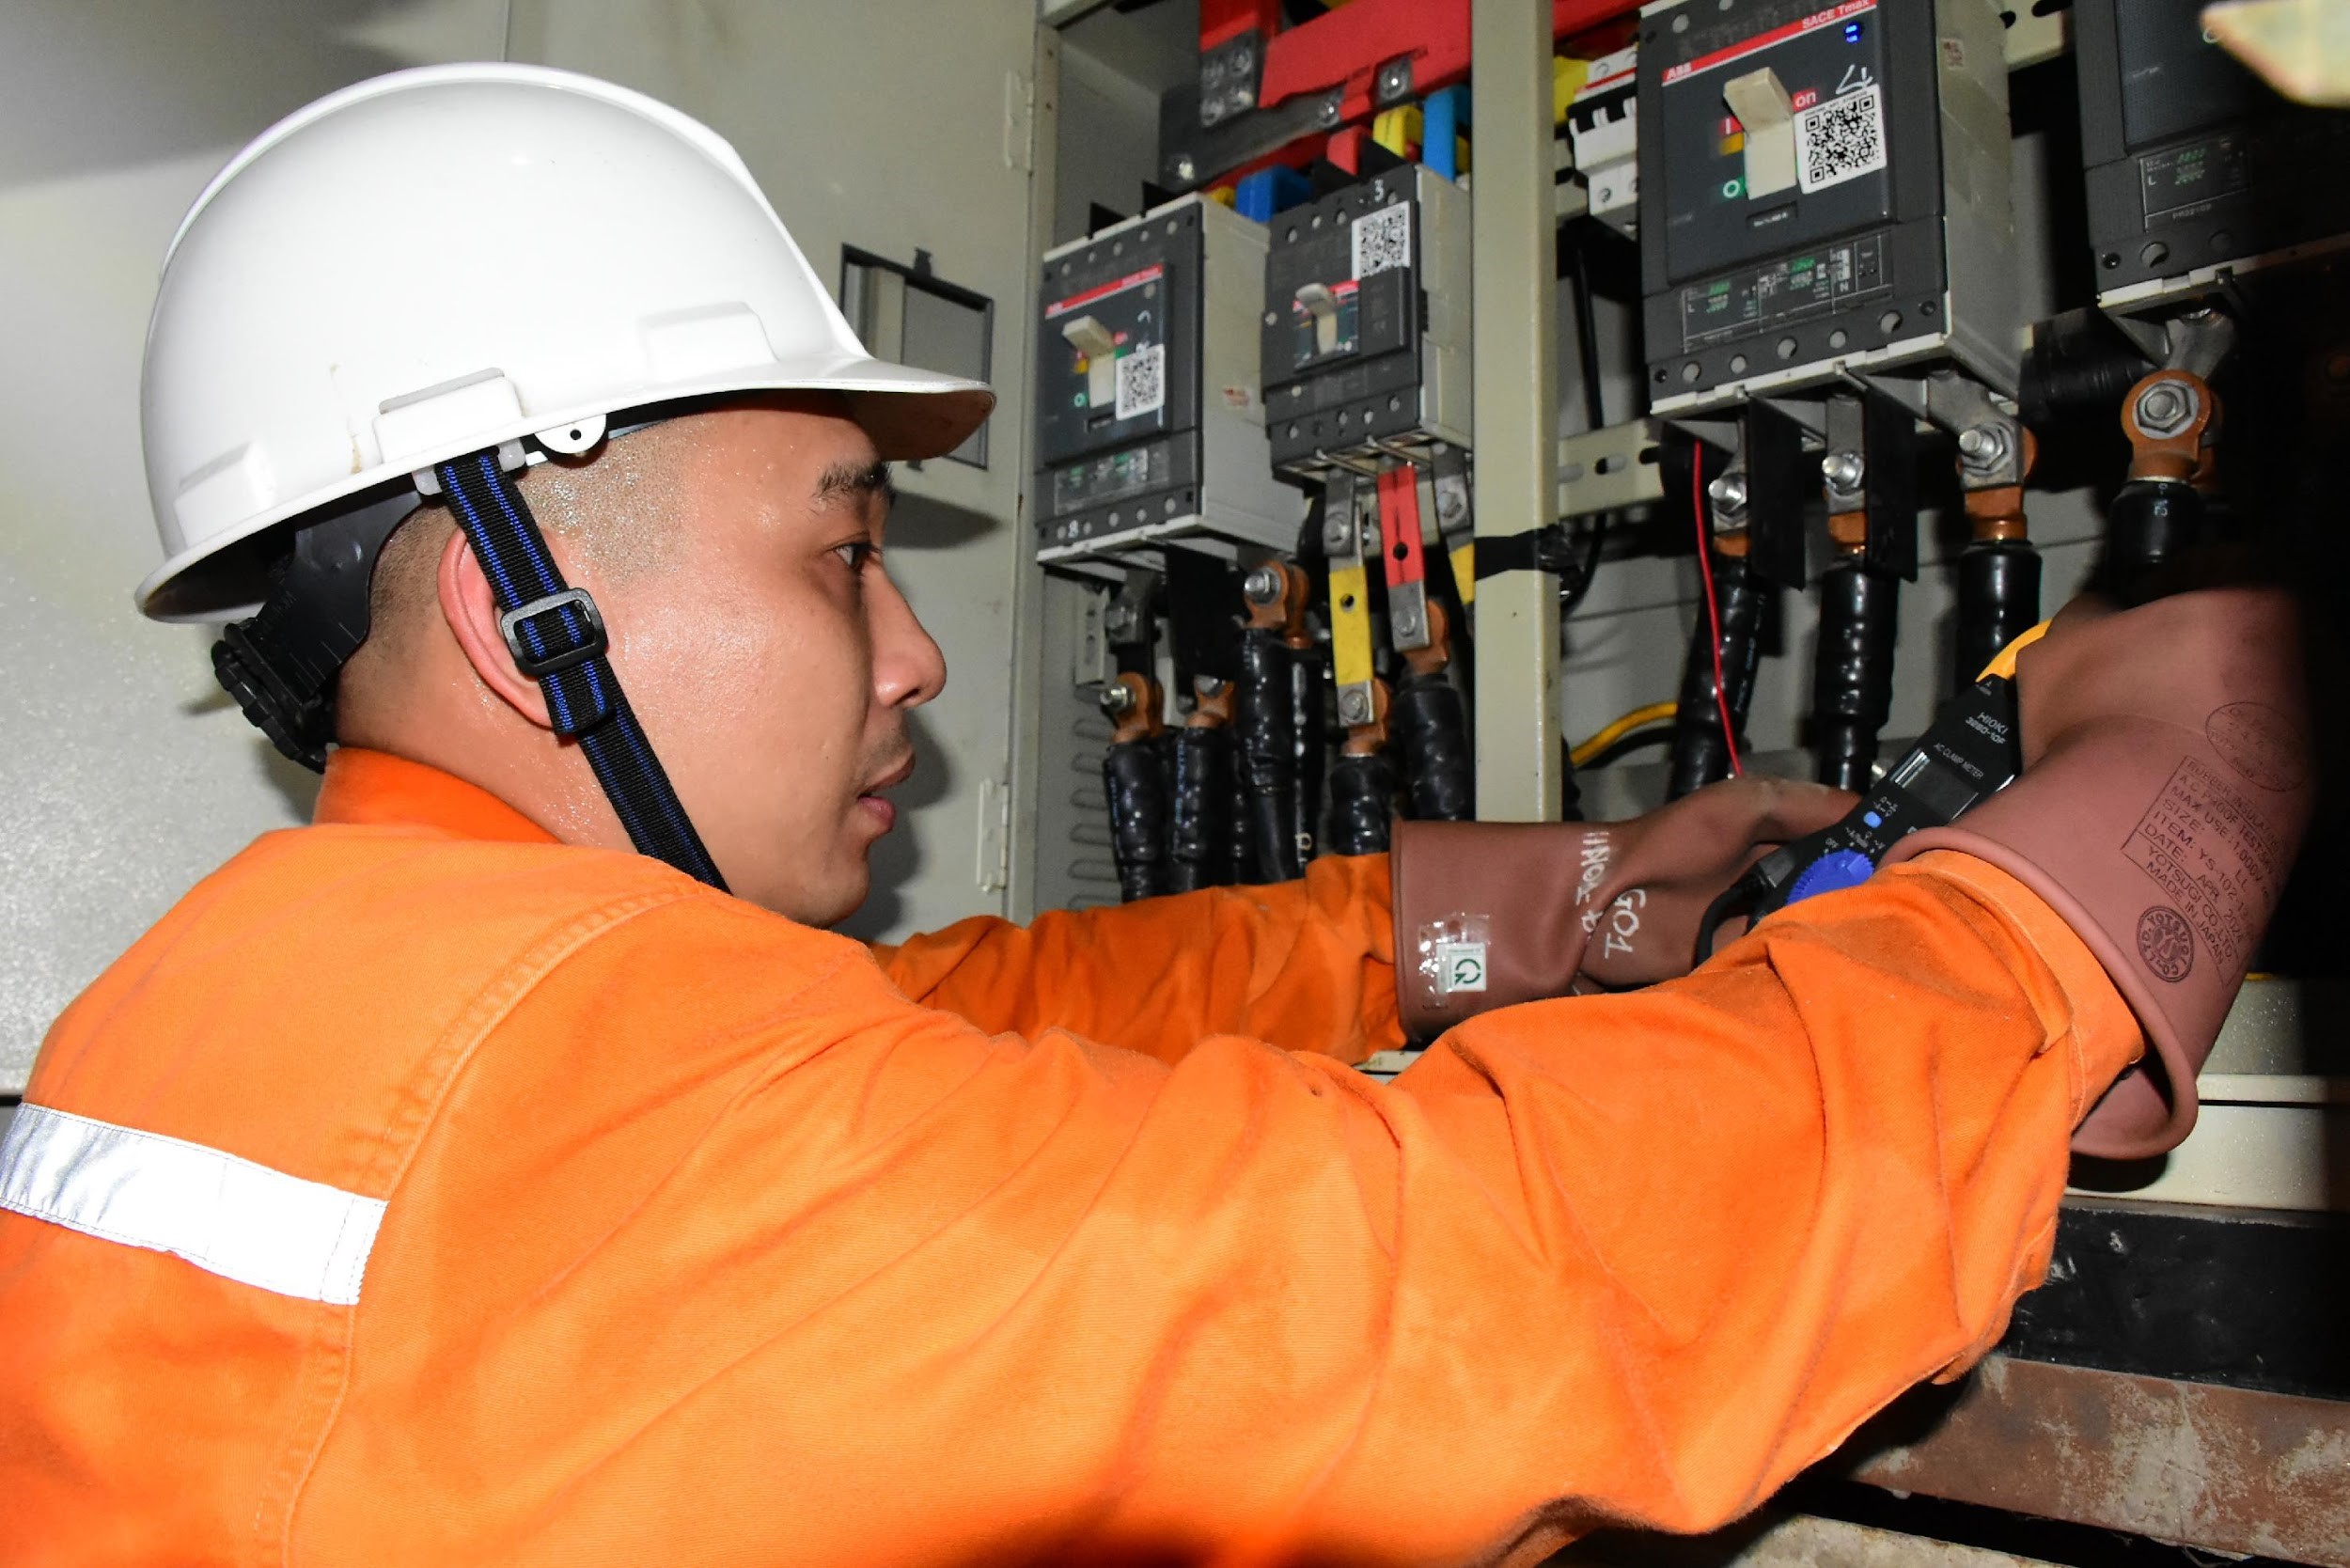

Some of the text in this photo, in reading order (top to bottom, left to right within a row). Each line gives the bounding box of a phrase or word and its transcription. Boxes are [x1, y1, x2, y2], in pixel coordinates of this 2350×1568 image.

[1801, 9, 1835, 29] SACE
[1666, 61, 1692, 80] ABB
[1835, 64, 1873, 95] 4
[1794, 90, 1816, 107] on
[1965, 716, 2007, 744] 3280-10F
[1977, 712, 2009, 734] HIOKI
[1942, 747, 1965, 764] CLAMP
[1961, 760, 1984, 780] METER
[2170, 786, 2201, 810] MAX
[2154, 810, 2196, 849] ITEM:
[2163, 798, 2205, 834] SIZE:
[2144, 823, 2187, 862] DATE:
[2148, 846, 2202, 903] YOTSUGI
[2146, 862, 2225, 964] MADE IN JAPAN
